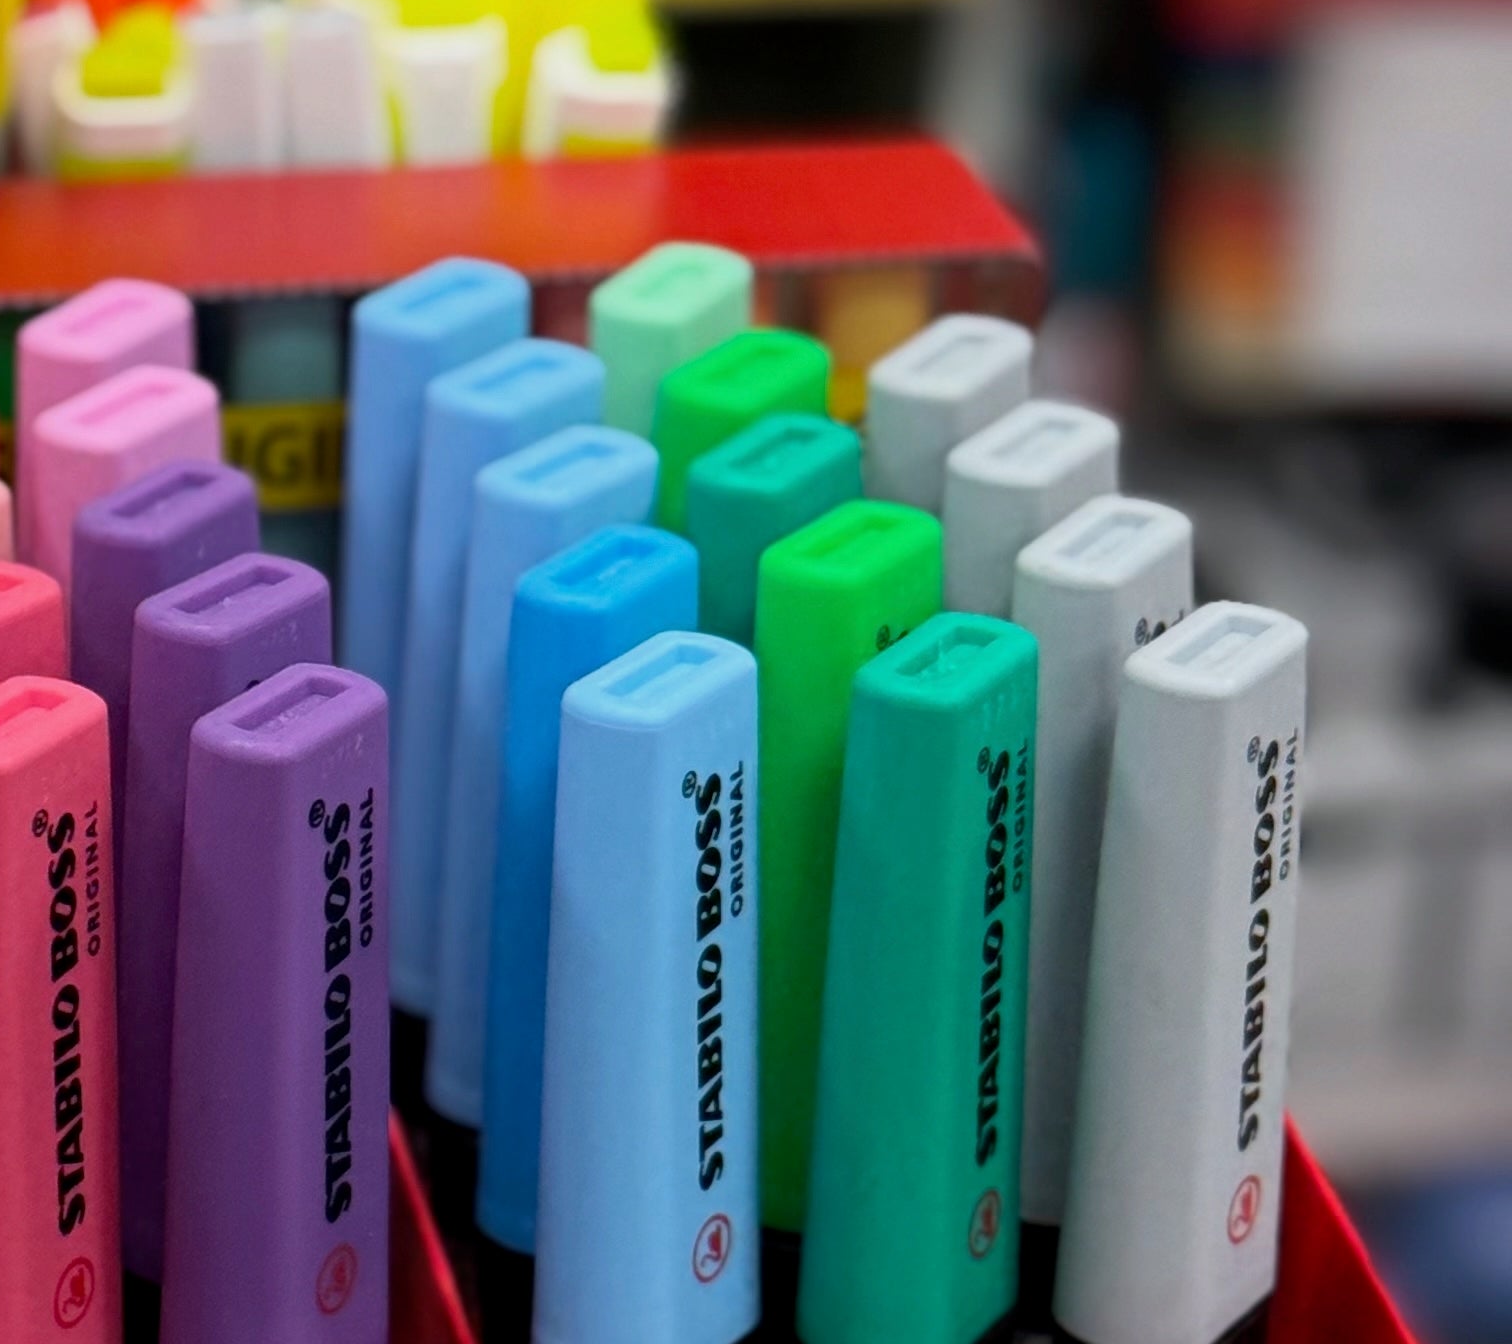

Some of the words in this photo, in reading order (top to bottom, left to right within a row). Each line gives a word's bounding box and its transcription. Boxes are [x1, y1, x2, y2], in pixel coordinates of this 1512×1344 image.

[85, 799, 102, 957] ORIGINAL
[359, 786, 375, 948] ORIGINAL
[730, 759, 745, 918] ORIGINAL
[1013, 737, 1029, 894] ORIGINAL
[1280, 726, 1300, 881] ORIGINAL
[51, 983, 86, 1237] STABILO
[324, 973, 353, 1224] STABILO
[696, 943, 724, 1192] STABILO
[975, 919, 1004, 1167] STABILO
[1238, 908, 1270, 1152] STABILO
